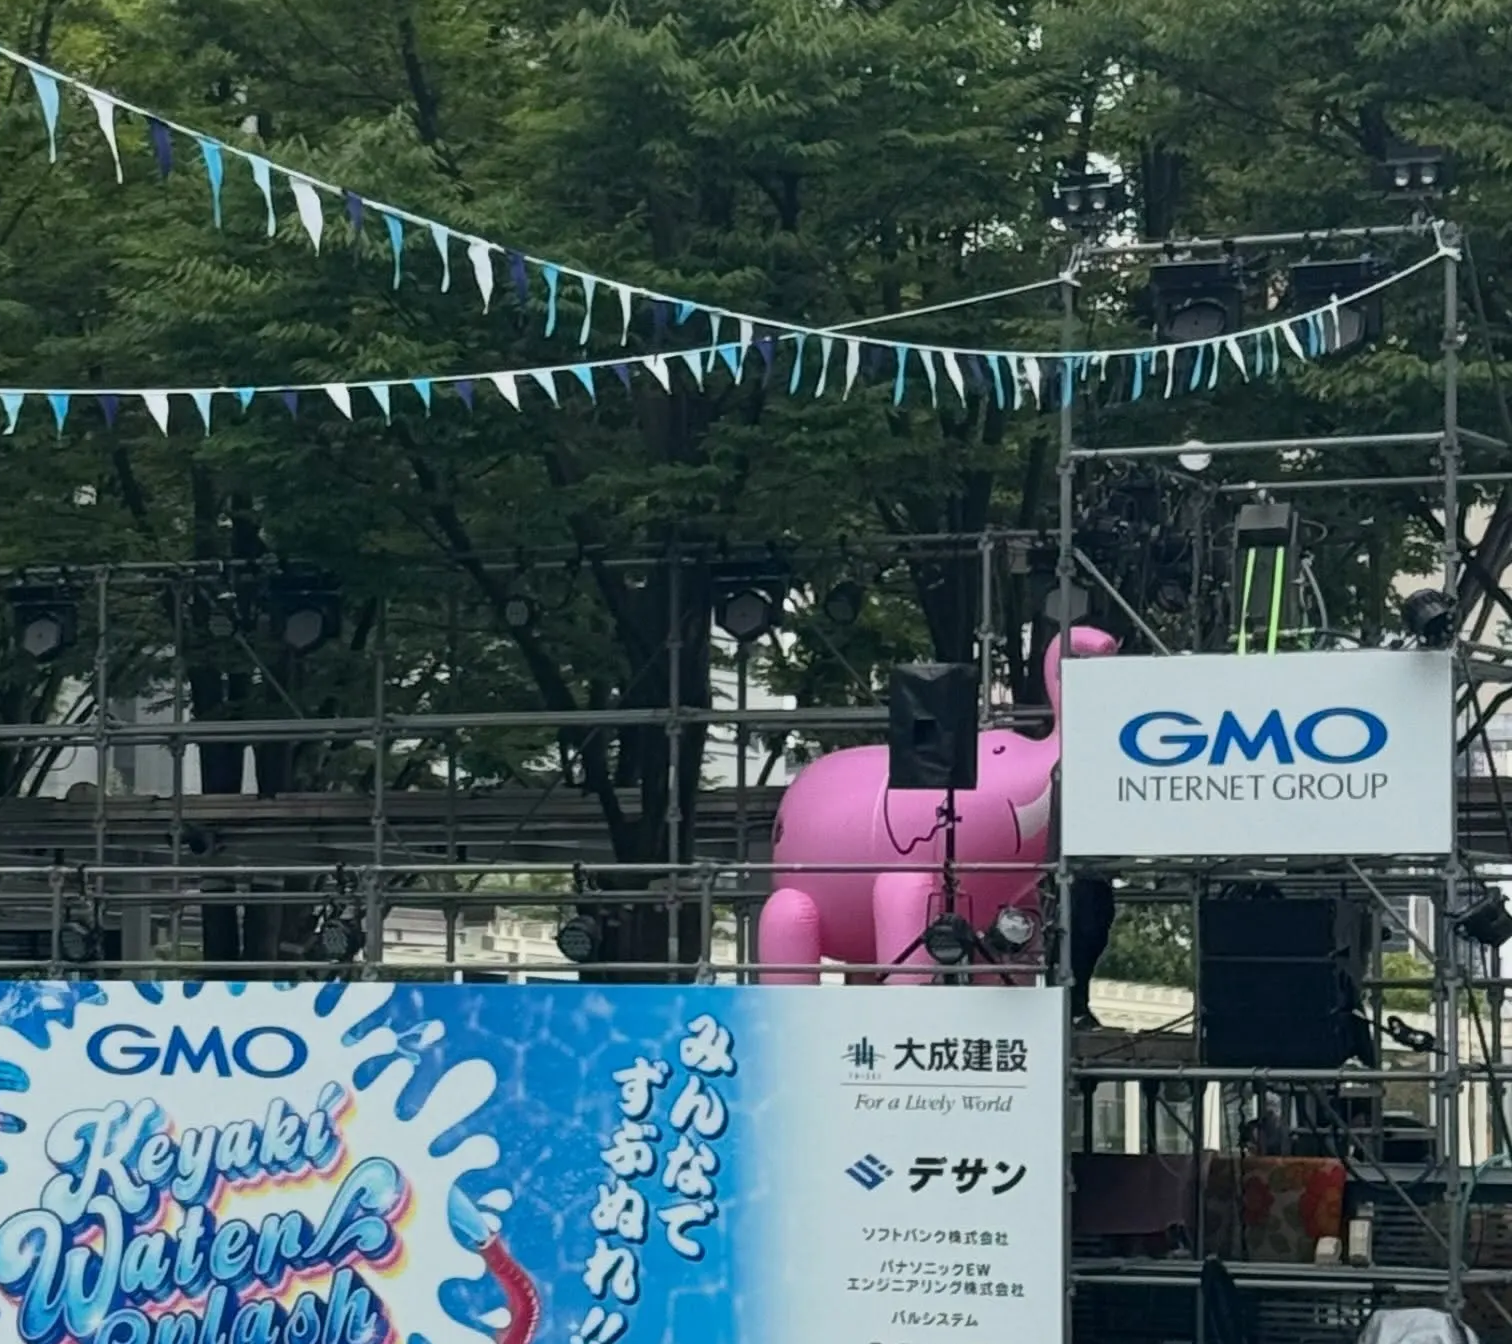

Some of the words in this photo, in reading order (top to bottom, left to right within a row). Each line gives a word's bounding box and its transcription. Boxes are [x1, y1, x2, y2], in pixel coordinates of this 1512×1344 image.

[1119, 707, 1388, 767] GMO
[1118, 774, 1265, 802] INTERNET
[1273, 773, 1388, 801] GROUP
[86, 1024, 308, 1079] GMO
[894, 1036, 1028, 1073] 大成建設
[854, 1094, 885, 1110] For
[888, 1097, 900, 1110] a
[905, 1094, 955, 1116] Lively
[962, 1095, 1013, 1112] World
[40, 1080, 350, 1224] Keyaki
[656, 1013, 737, 1261] みんなで
[908, 1156, 1027, 1196] デサン
[862, 1227, 1009, 1246] ソフトバンク株式会社
[880, 1259, 991, 1277] パナソニックEW
[847, 1277, 1024, 1297] エンジニアリング株式会社
[891, 1310, 979, 1327] パルシステム
